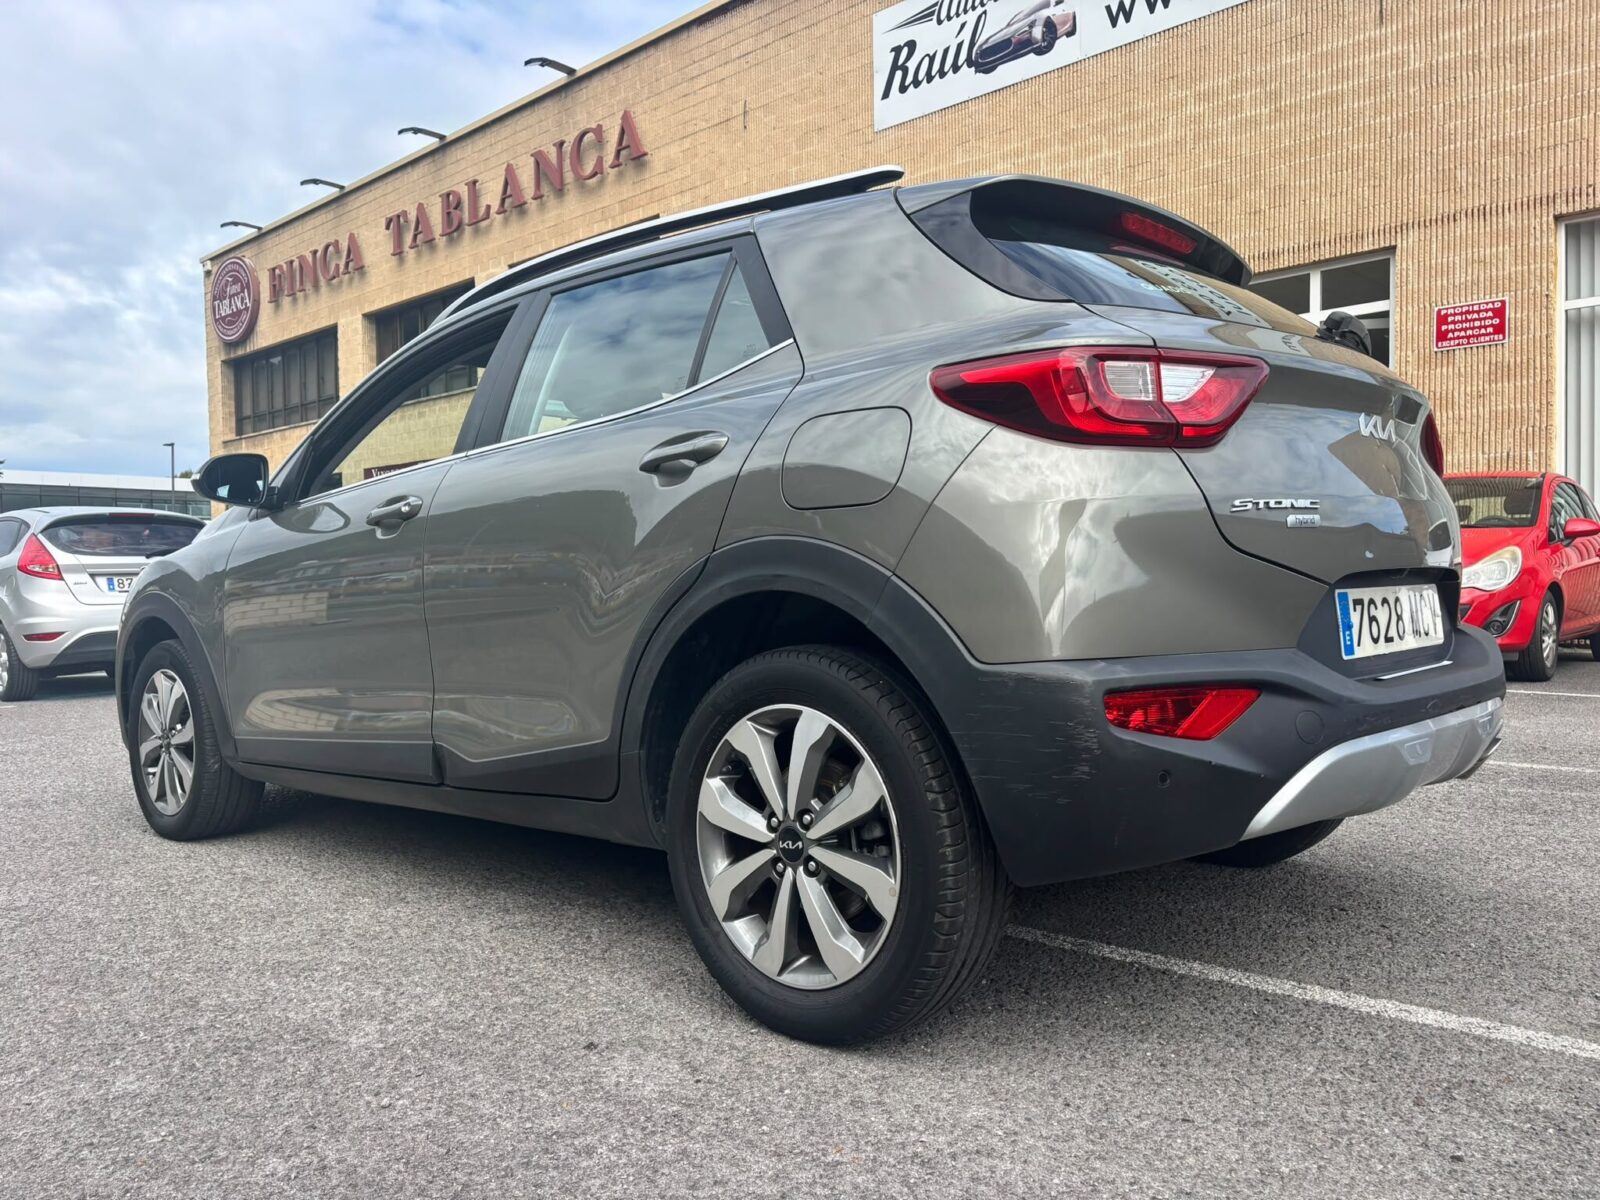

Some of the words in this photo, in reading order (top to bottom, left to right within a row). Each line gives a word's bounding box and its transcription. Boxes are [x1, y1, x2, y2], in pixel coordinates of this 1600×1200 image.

[881, 9, 987, 101] Raúl
[267, 232, 365, 303] FINCA
[385, 110, 648, 256] TABLANCA
[214, 289, 250, 319] TABLANCA
[1440, 302, 1502, 315] PROPIEDAD
[1447, 311, 1494, 322] PRIVADA
[1441, 318, 1500, 331] PROHIBIDO
[1447, 327, 1494, 339] APARCAR
[1437, 338, 1468, 348] EXCEPTO
[1469, 334, 1503, 343] CLIENTES
[1359, 412, 1396, 442] KIA
[1230, 498, 1320, 512] STONIC
[1352, 596, 1406, 648] 7628
[780, 840, 803, 849] KIA
